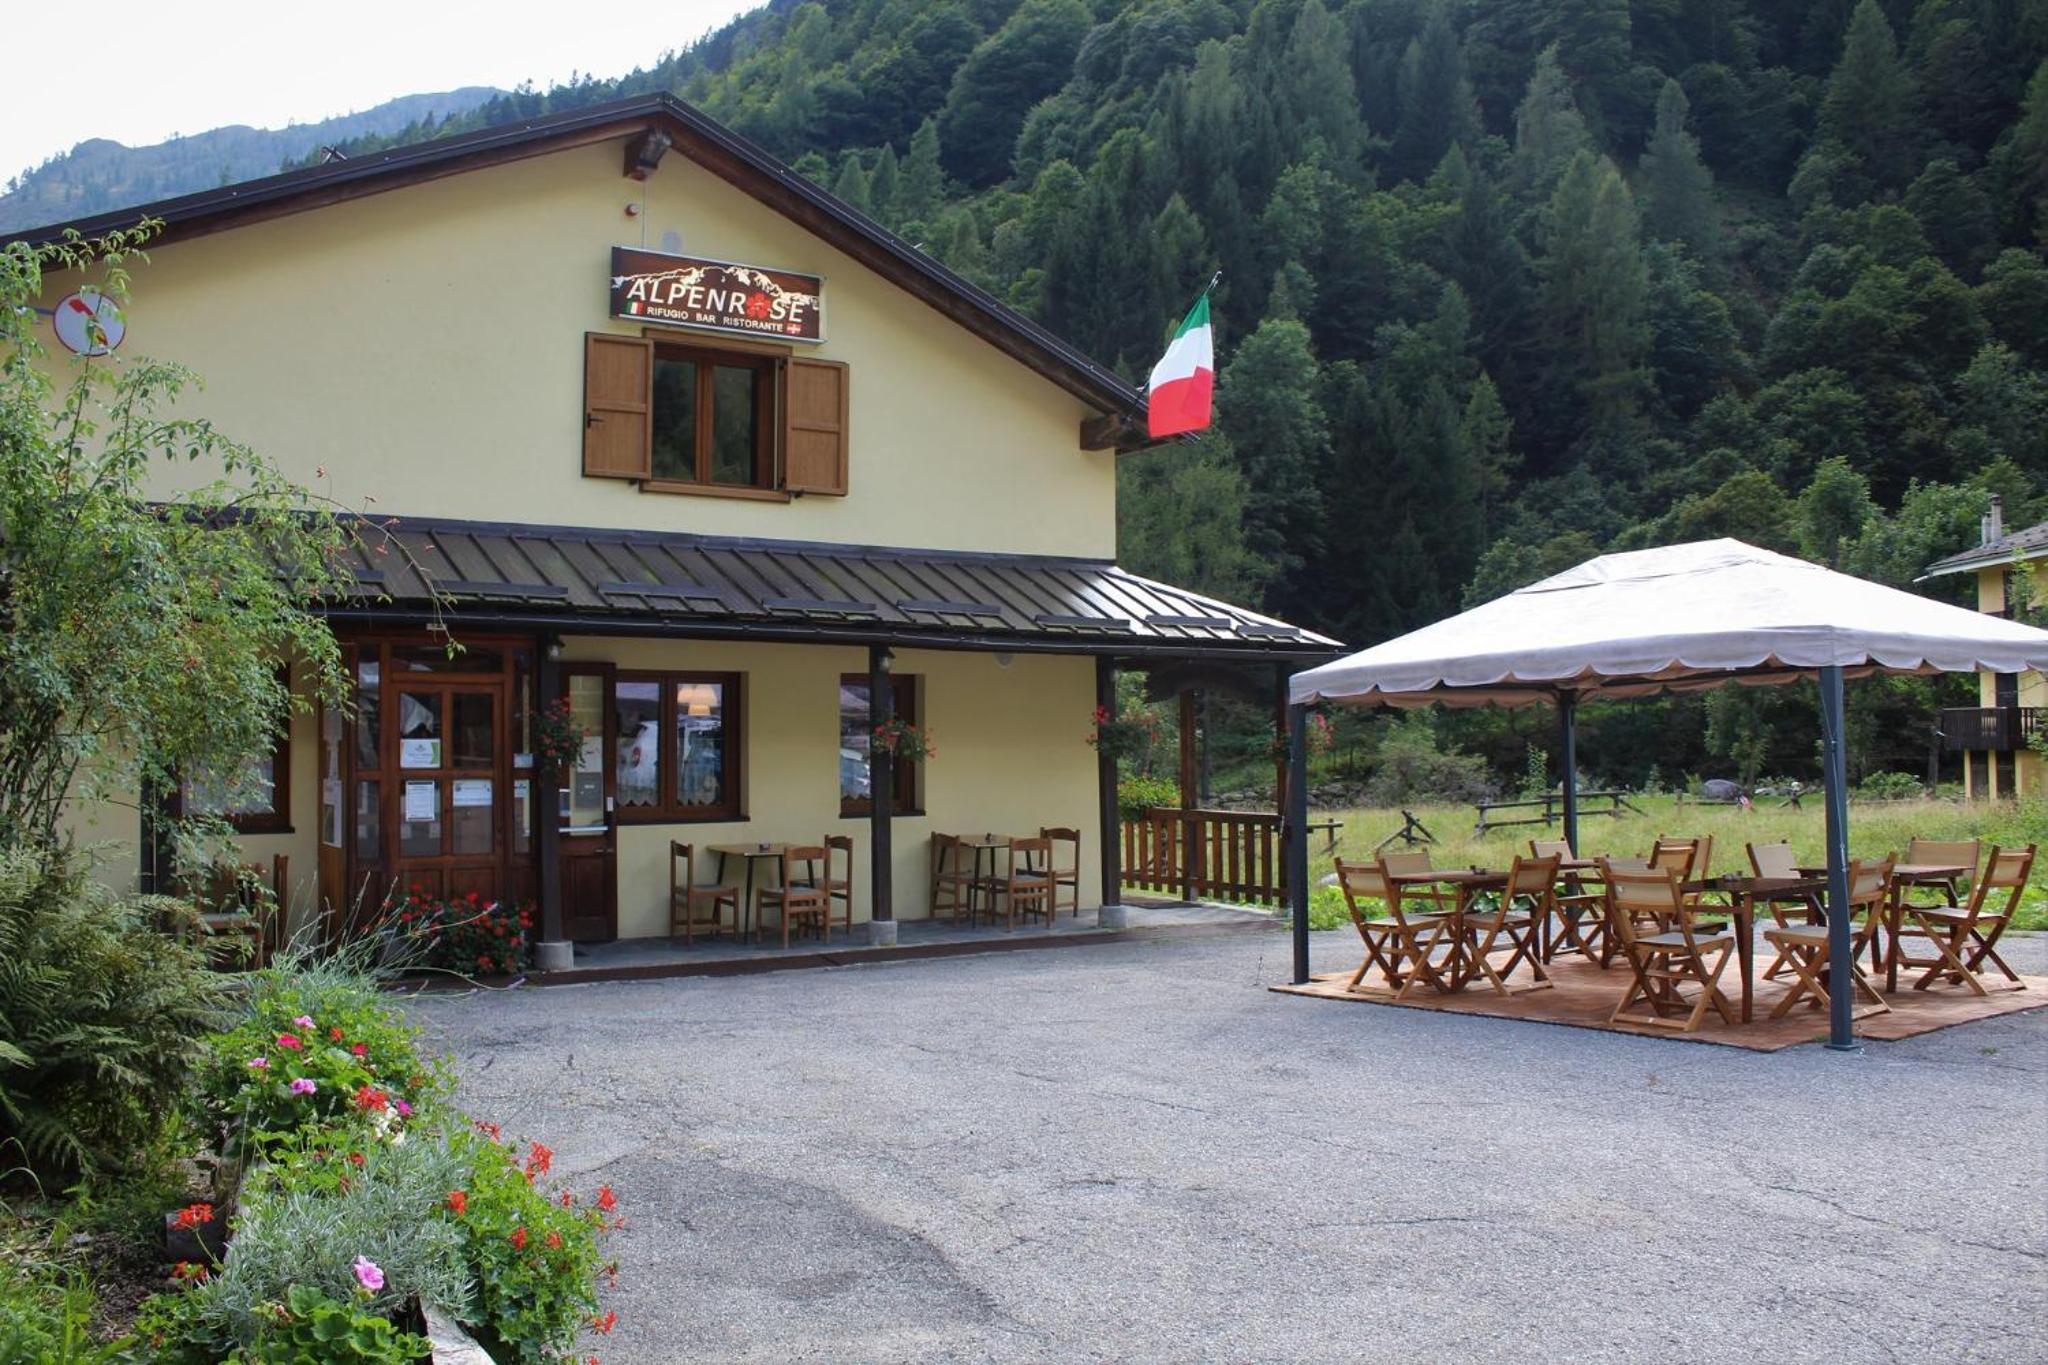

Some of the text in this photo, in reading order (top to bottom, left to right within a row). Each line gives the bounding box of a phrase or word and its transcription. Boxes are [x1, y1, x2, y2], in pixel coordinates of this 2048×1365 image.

[647, 306, 783, 332] RIFUGIO BAR RISTORANTE
